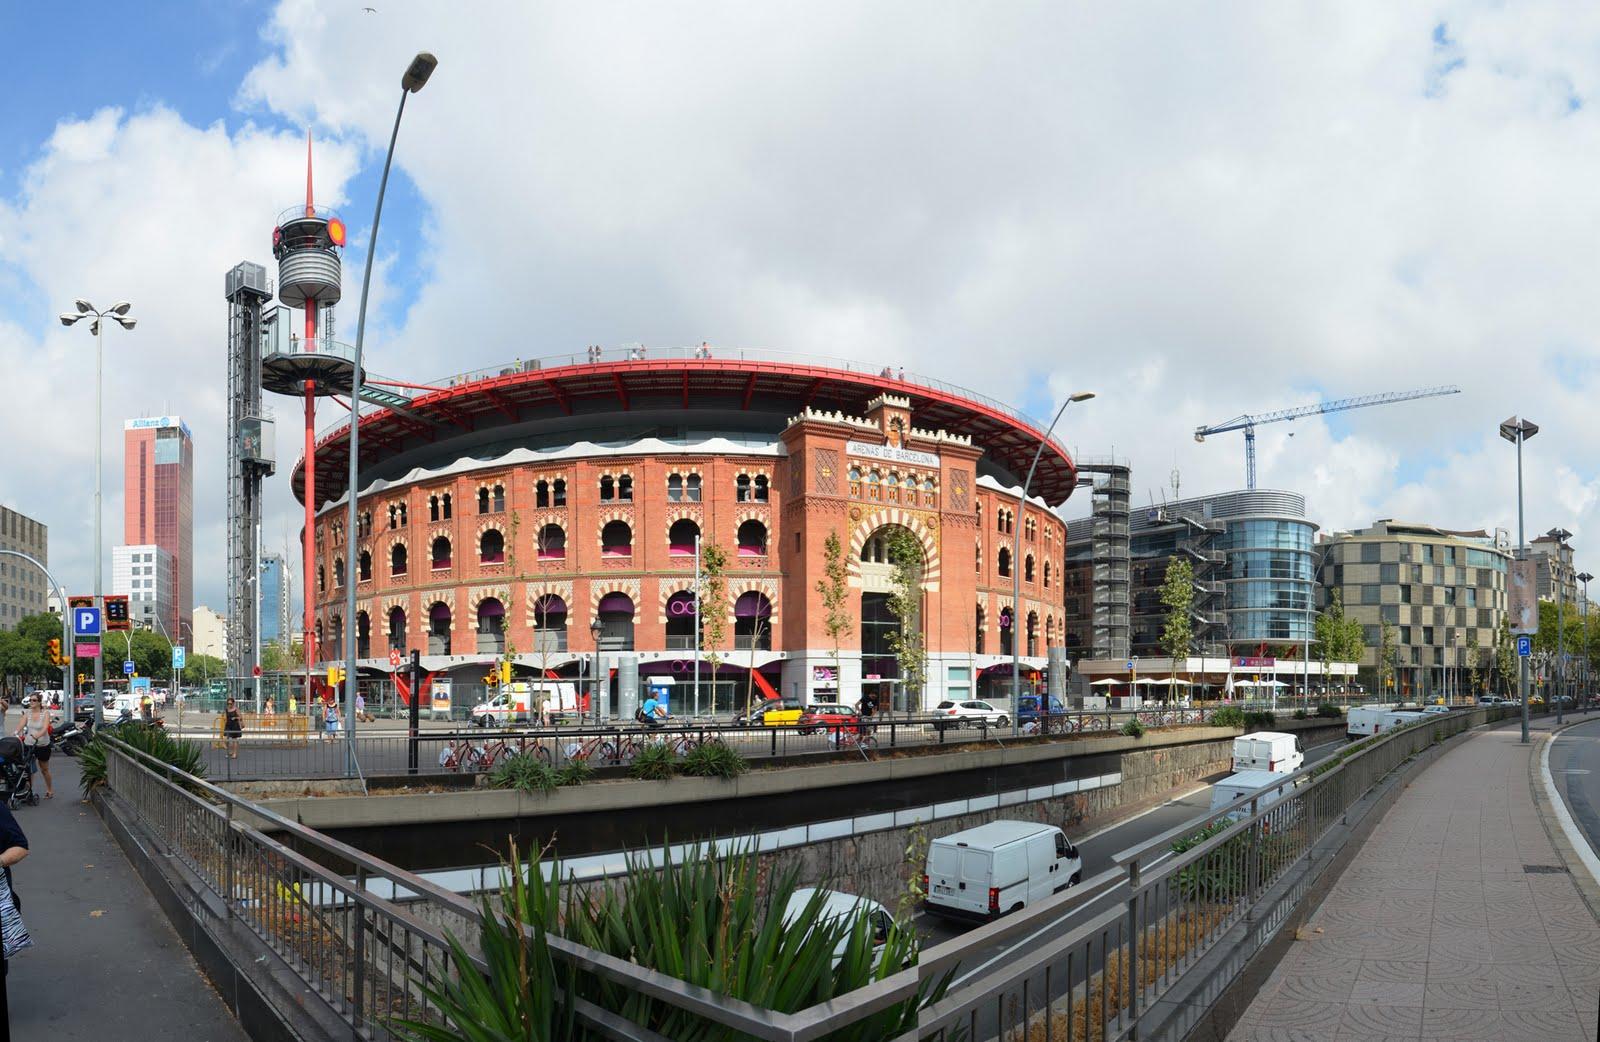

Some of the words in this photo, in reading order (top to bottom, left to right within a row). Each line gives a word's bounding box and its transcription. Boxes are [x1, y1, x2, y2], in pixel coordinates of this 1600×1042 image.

[133, 419, 159, 428] Allianz
[852, 444, 880, 456] ARENAS
[883, 448, 893, 458] DE
[896, 449, 935, 465] BARCELONA
[81, 612, 94, 630] P
[1520, 640, 1528, 650] P
[174, 648, 182, 659] P
